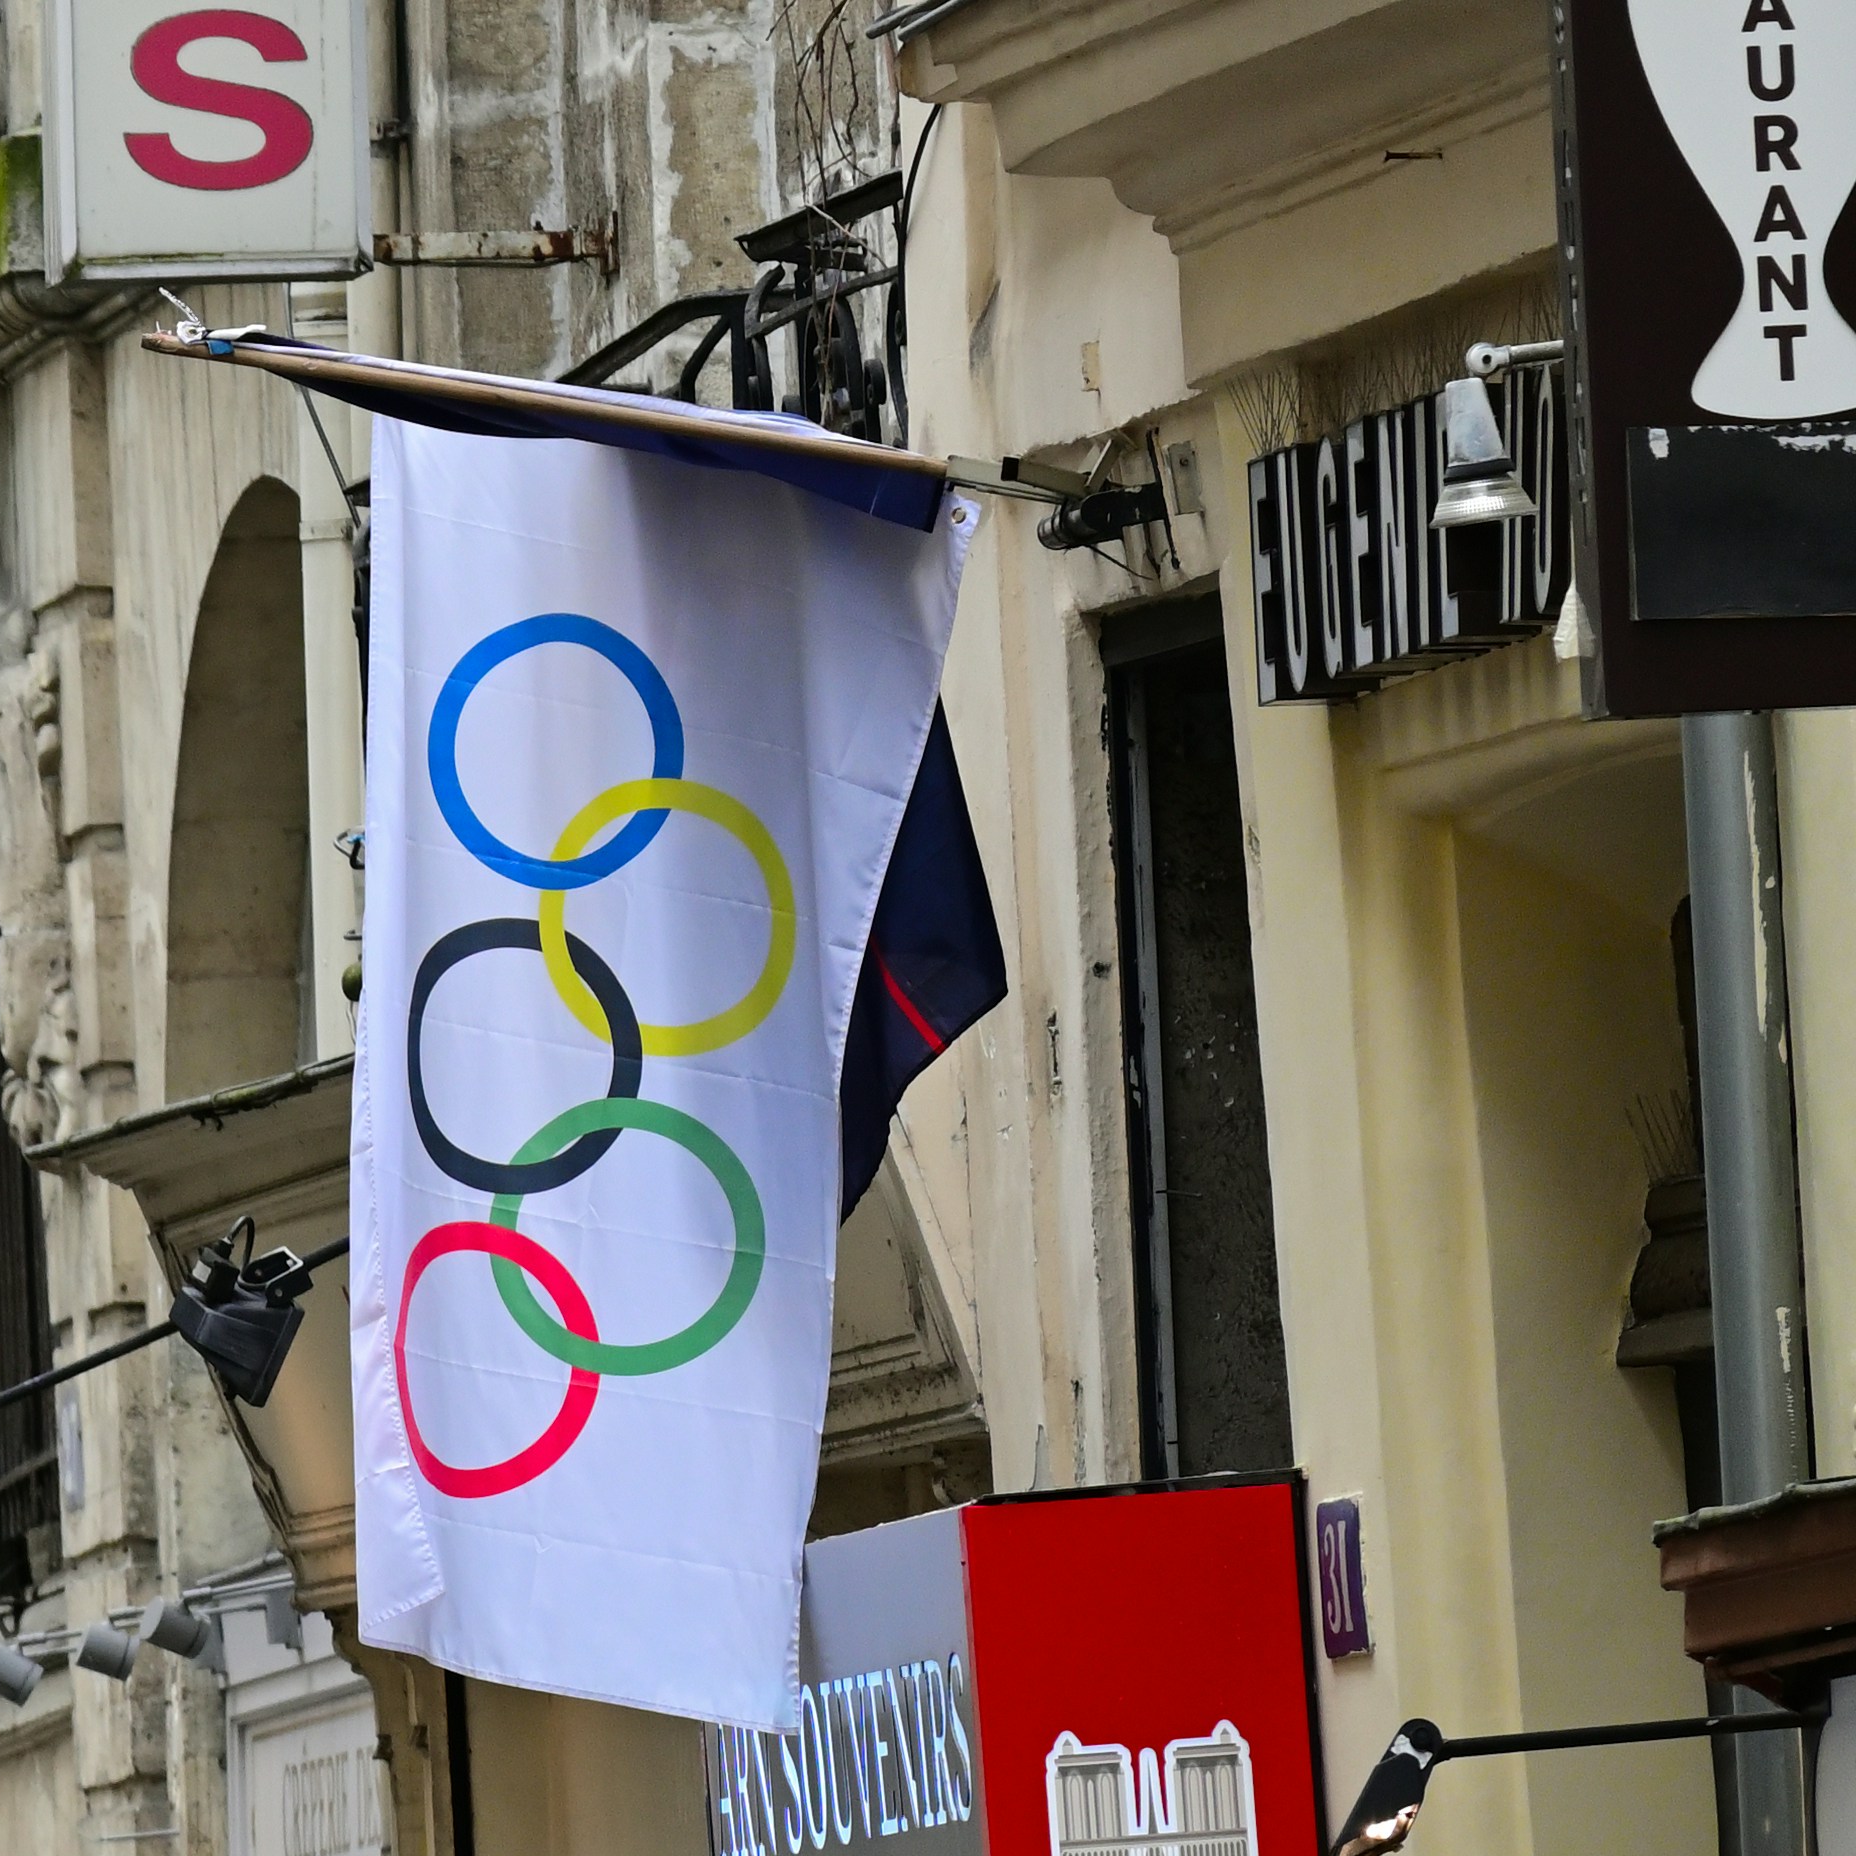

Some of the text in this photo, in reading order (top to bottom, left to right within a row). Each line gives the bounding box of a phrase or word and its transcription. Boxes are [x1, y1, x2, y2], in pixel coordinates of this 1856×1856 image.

[122, 8, 314, 191] S
[1741, 0, 1809, 382] AURANT
[1323, 1519, 1355, 1634] 31
[779, 1651, 973, 1855] SOUVENIRS
